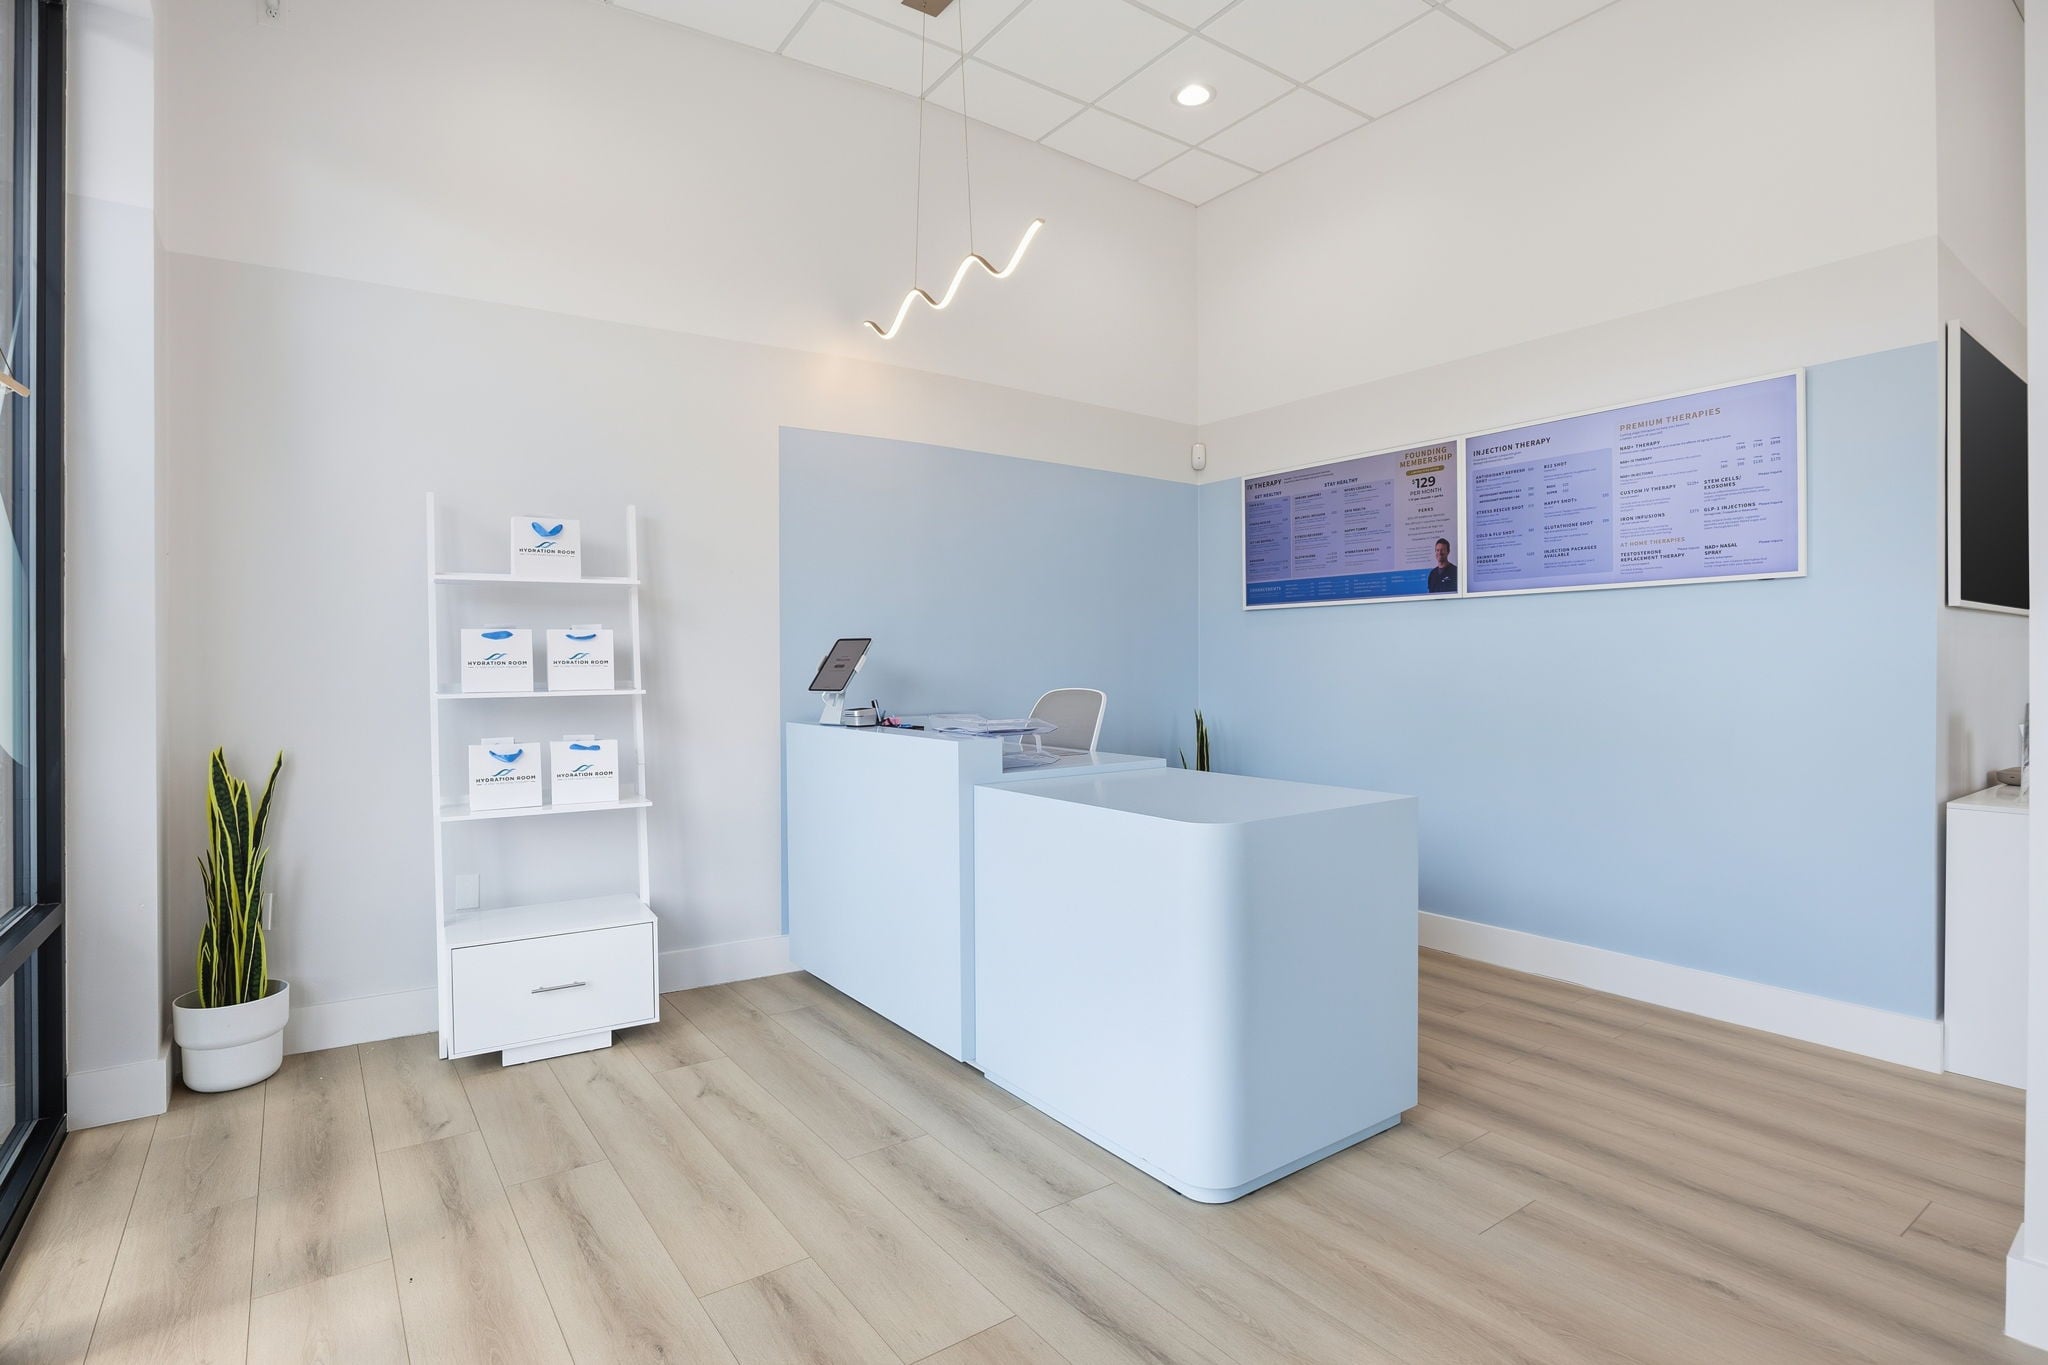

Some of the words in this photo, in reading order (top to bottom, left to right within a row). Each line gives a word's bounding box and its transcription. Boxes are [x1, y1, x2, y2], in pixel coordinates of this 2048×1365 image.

[1620, 418, 1663, 431] PREMIUM
[1666, 407, 1721, 423] THERAPIES
[1473, 444, 1513, 456] INJECTION
[1515, 437, 1551, 449] THERAPY
[1635, 440, 1661, 449] THERAPY
[1405, 446, 1447, 460] FOUNDING
[1400, 453, 1452, 468] MEMBERSHIP
[1254, 479, 1282, 489] THERAPY
[1412, 476, 1436, 489] $129
[1704, 482, 1736, 490] EXOSOMES
[1651, 484, 1676, 492] THERAPY
[1721, 502, 1756, 510] INJECTIONS
[1544, 522, 1578, 530] GLUTATHIONE
[1650, 537, 1686, 545] THERAPIES
[1620, 549, 1662, 557] TESTOSTERONE
